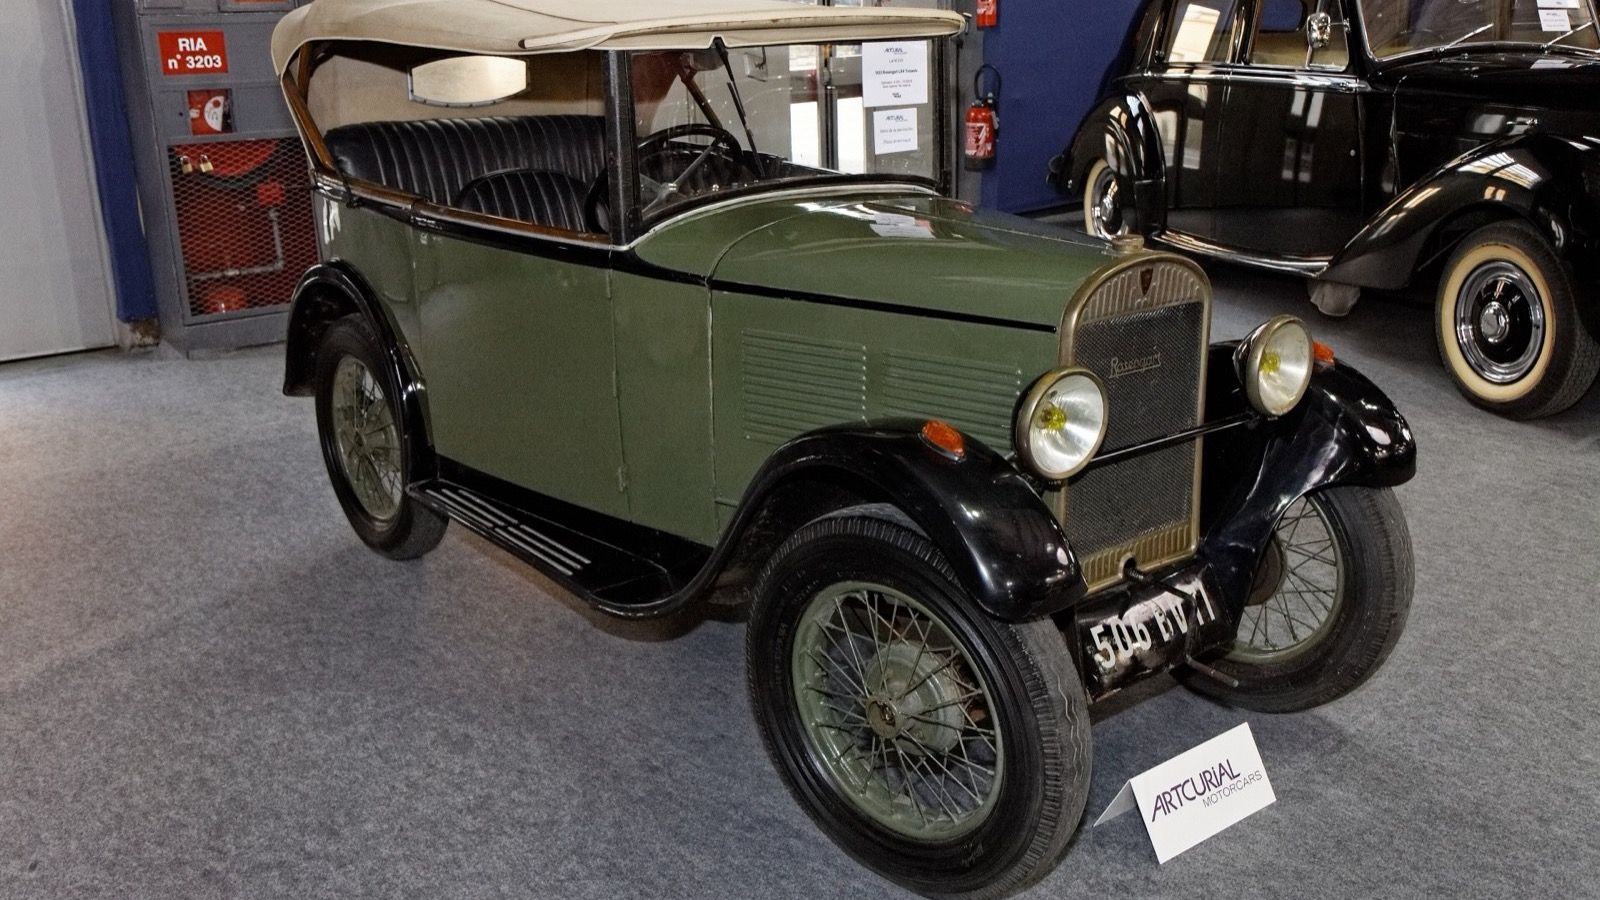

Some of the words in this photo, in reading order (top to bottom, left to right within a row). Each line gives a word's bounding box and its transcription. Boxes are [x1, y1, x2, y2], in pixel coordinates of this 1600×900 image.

[177, 37, 208, 52] RIA
[167, 54, 182, 70] n°
[186, 55, 223, 69] 3203
[1089, 609, 1152, 669] 506
[1202, 769, 1263, 808] MOTORCARS
